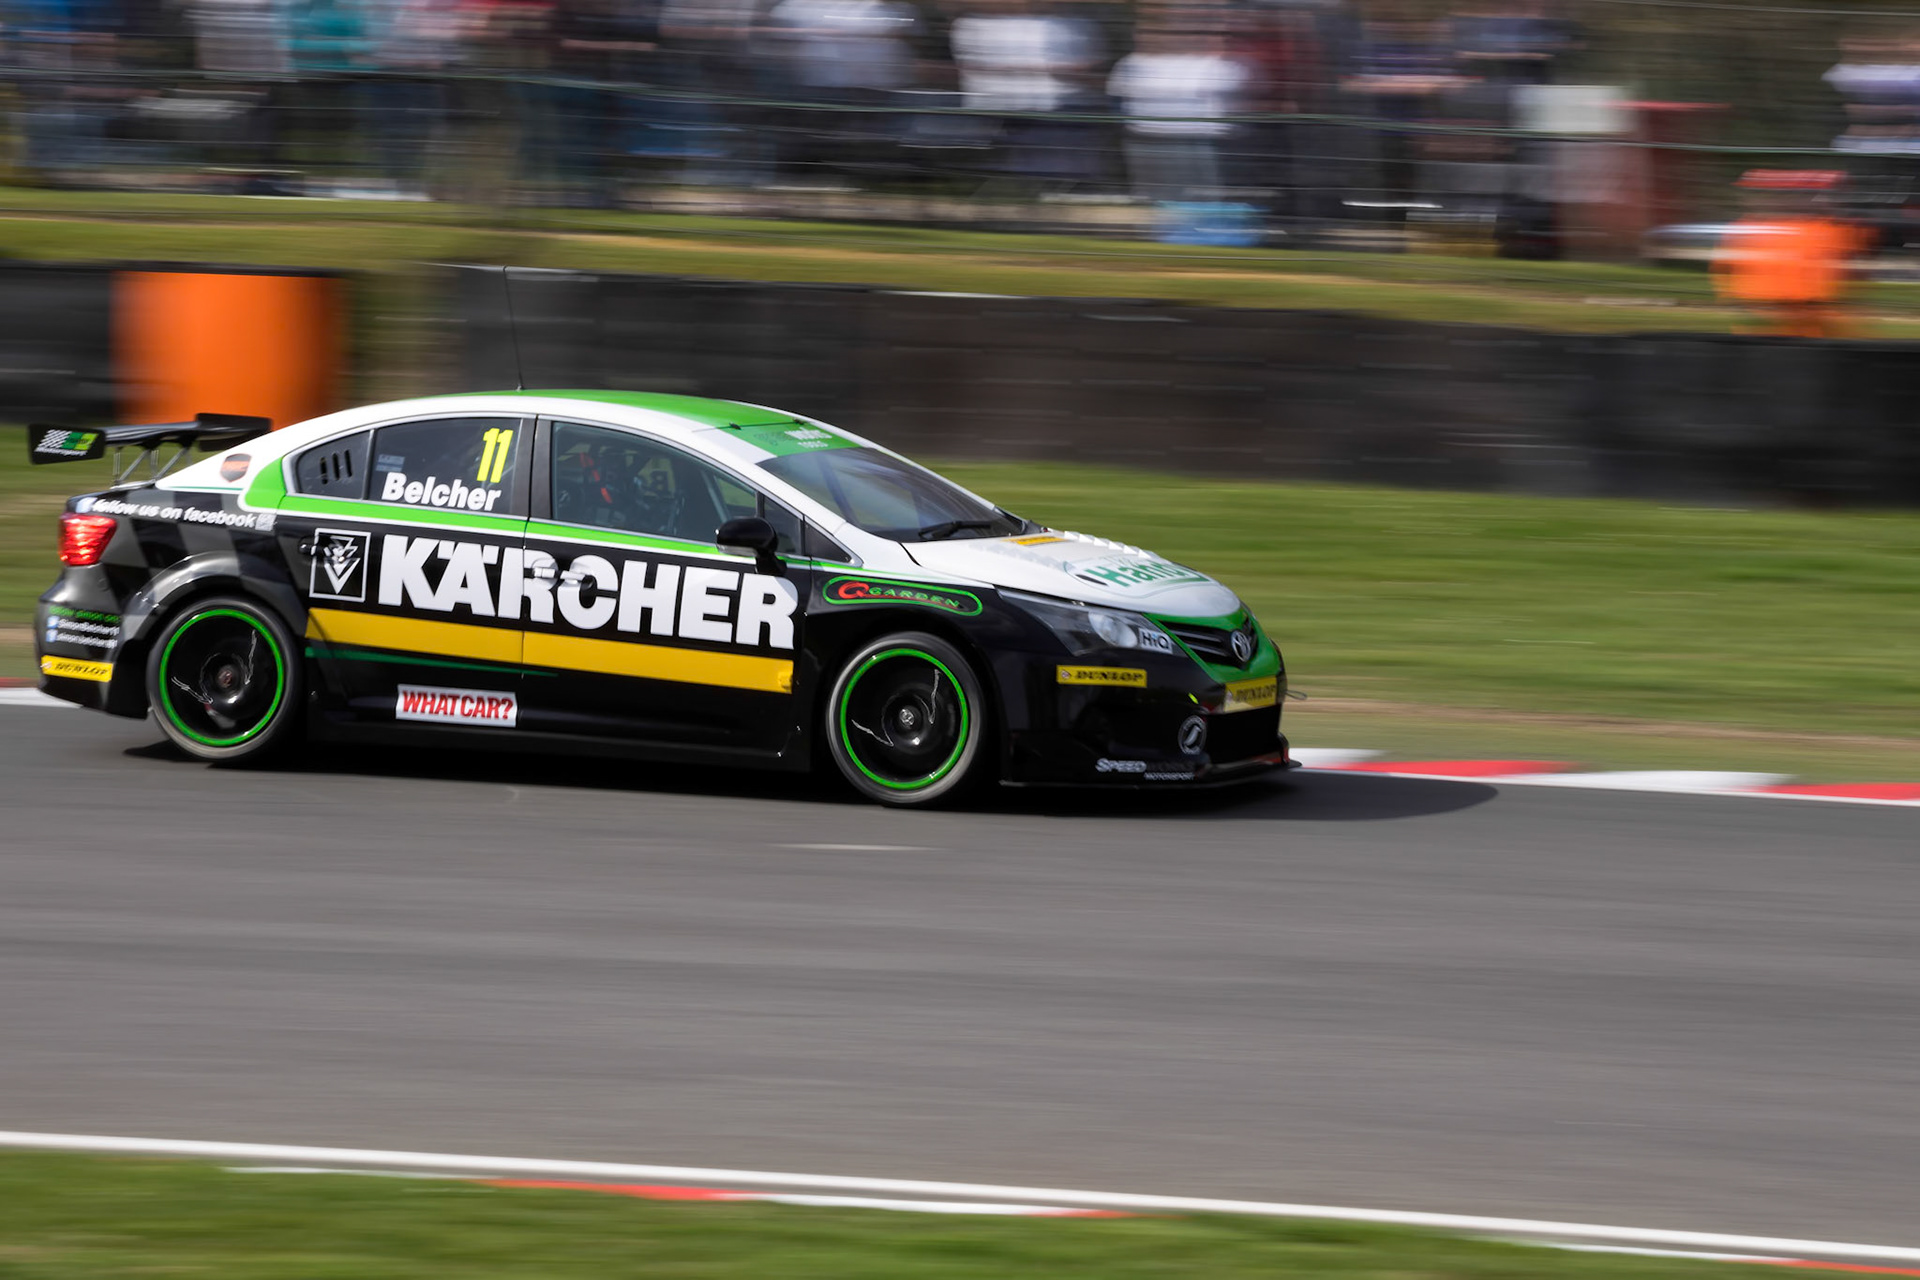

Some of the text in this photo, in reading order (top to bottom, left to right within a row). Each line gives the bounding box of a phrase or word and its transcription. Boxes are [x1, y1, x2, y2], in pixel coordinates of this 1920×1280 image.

[477, 428, 513, 483] 11
[381, 471, 502, 511] Belcher
[138, 504, 160, 517] us
[160, 507, 183, 519] on
[183, 506, 257, 527] facebook
[378, 534, 799, 649] KÄRCHER
[1142, 631, 1169, 649] HiQ
[1076, 670, 1143, 682] DUNLOP
